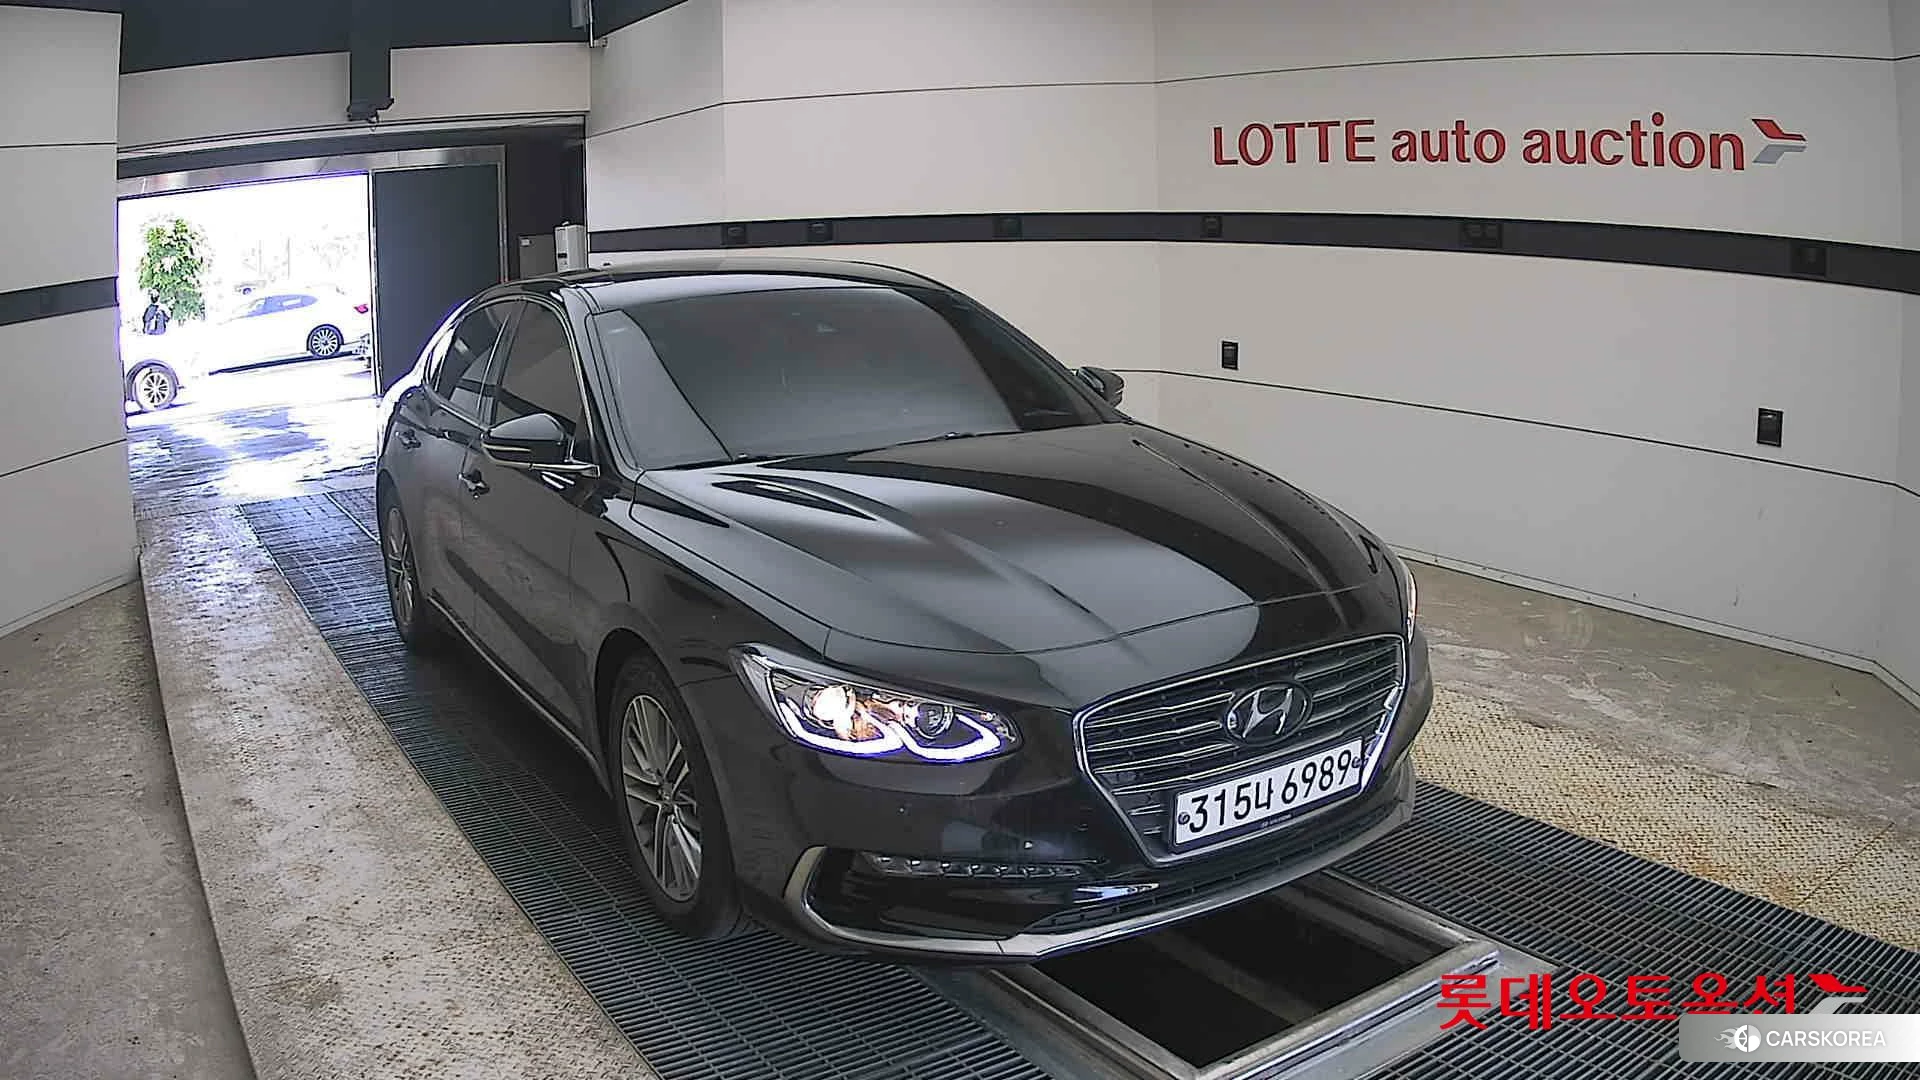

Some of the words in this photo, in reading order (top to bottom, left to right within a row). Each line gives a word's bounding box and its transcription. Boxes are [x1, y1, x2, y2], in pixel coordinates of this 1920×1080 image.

[1212, 119, 1376, 167] LOTTE
[1390, 119, 1507, 164] auto
[1522, 112, 1746, 171] auction
[1281, 749, 1351, 805] 6989
